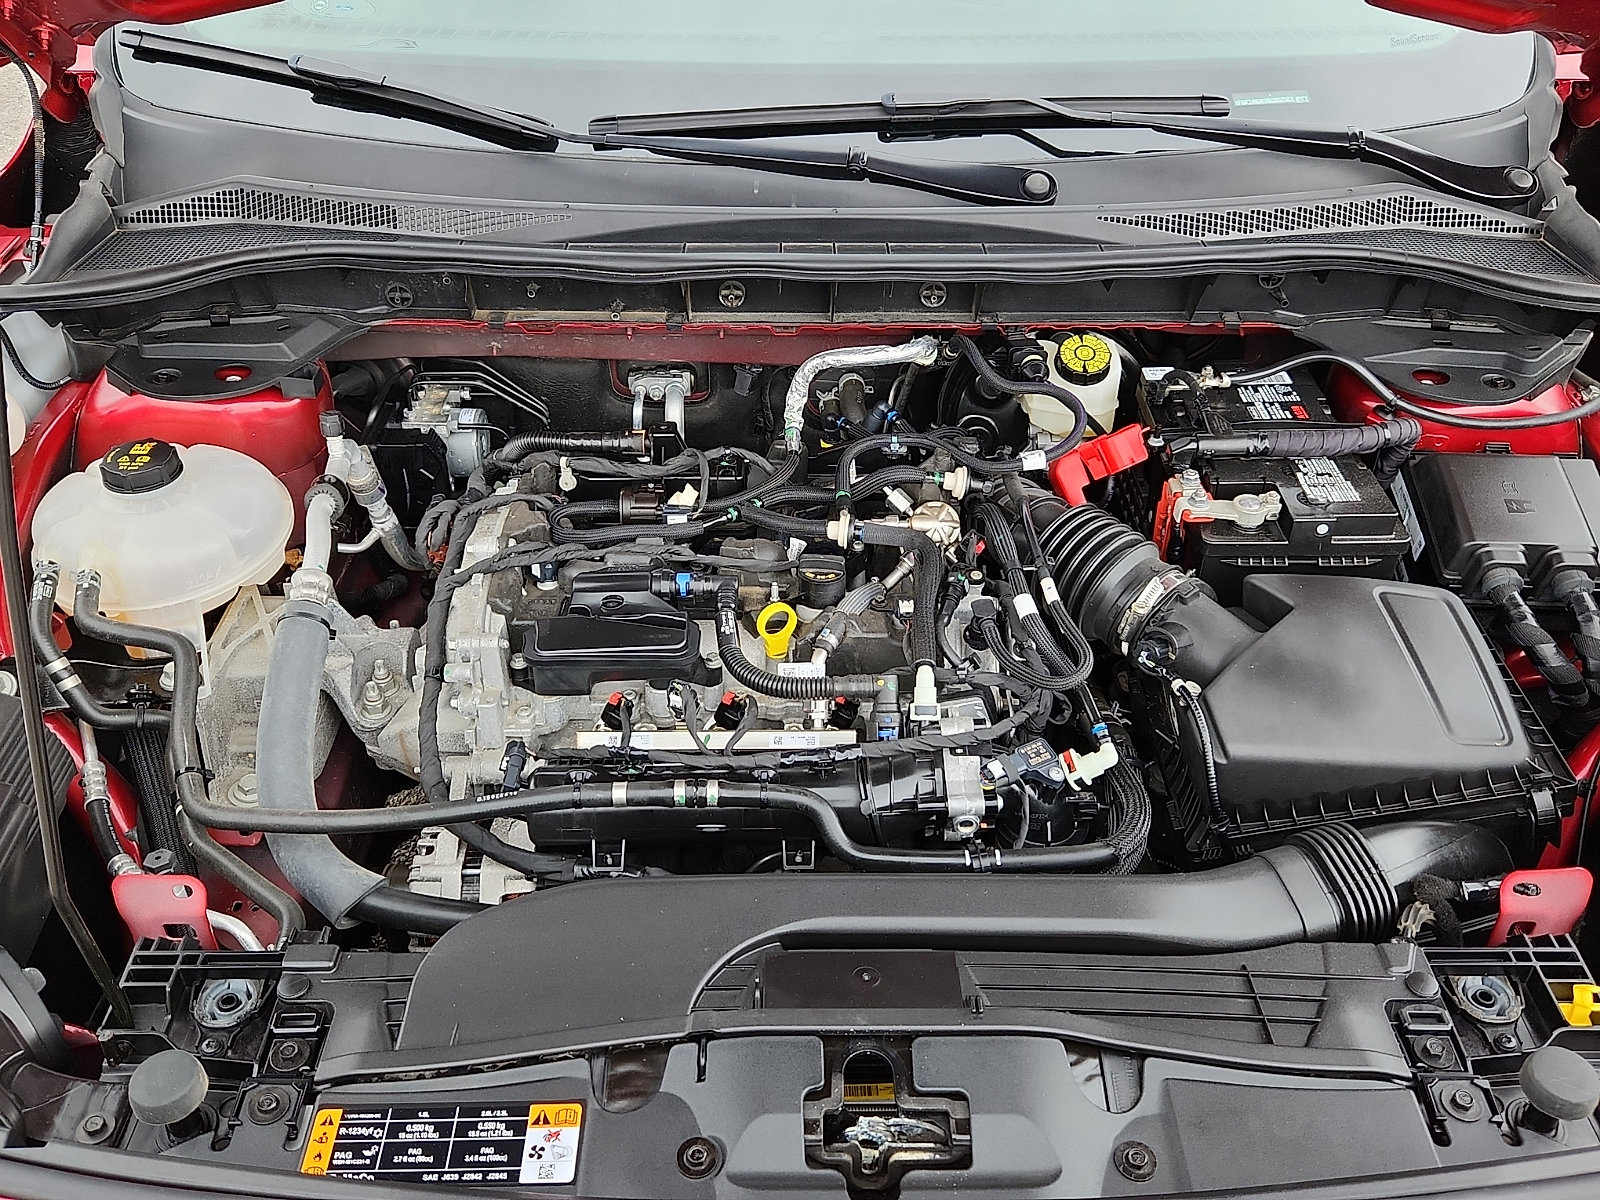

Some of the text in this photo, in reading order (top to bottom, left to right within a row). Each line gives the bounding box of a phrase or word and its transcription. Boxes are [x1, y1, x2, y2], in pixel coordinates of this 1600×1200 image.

[339, 1126, 374, 1136] R-1234yf
[479, 1146, 494, 1154] PAG
[334, 1151, 353, 1159] PAG
[441, 1173, 460, 1181] J639
